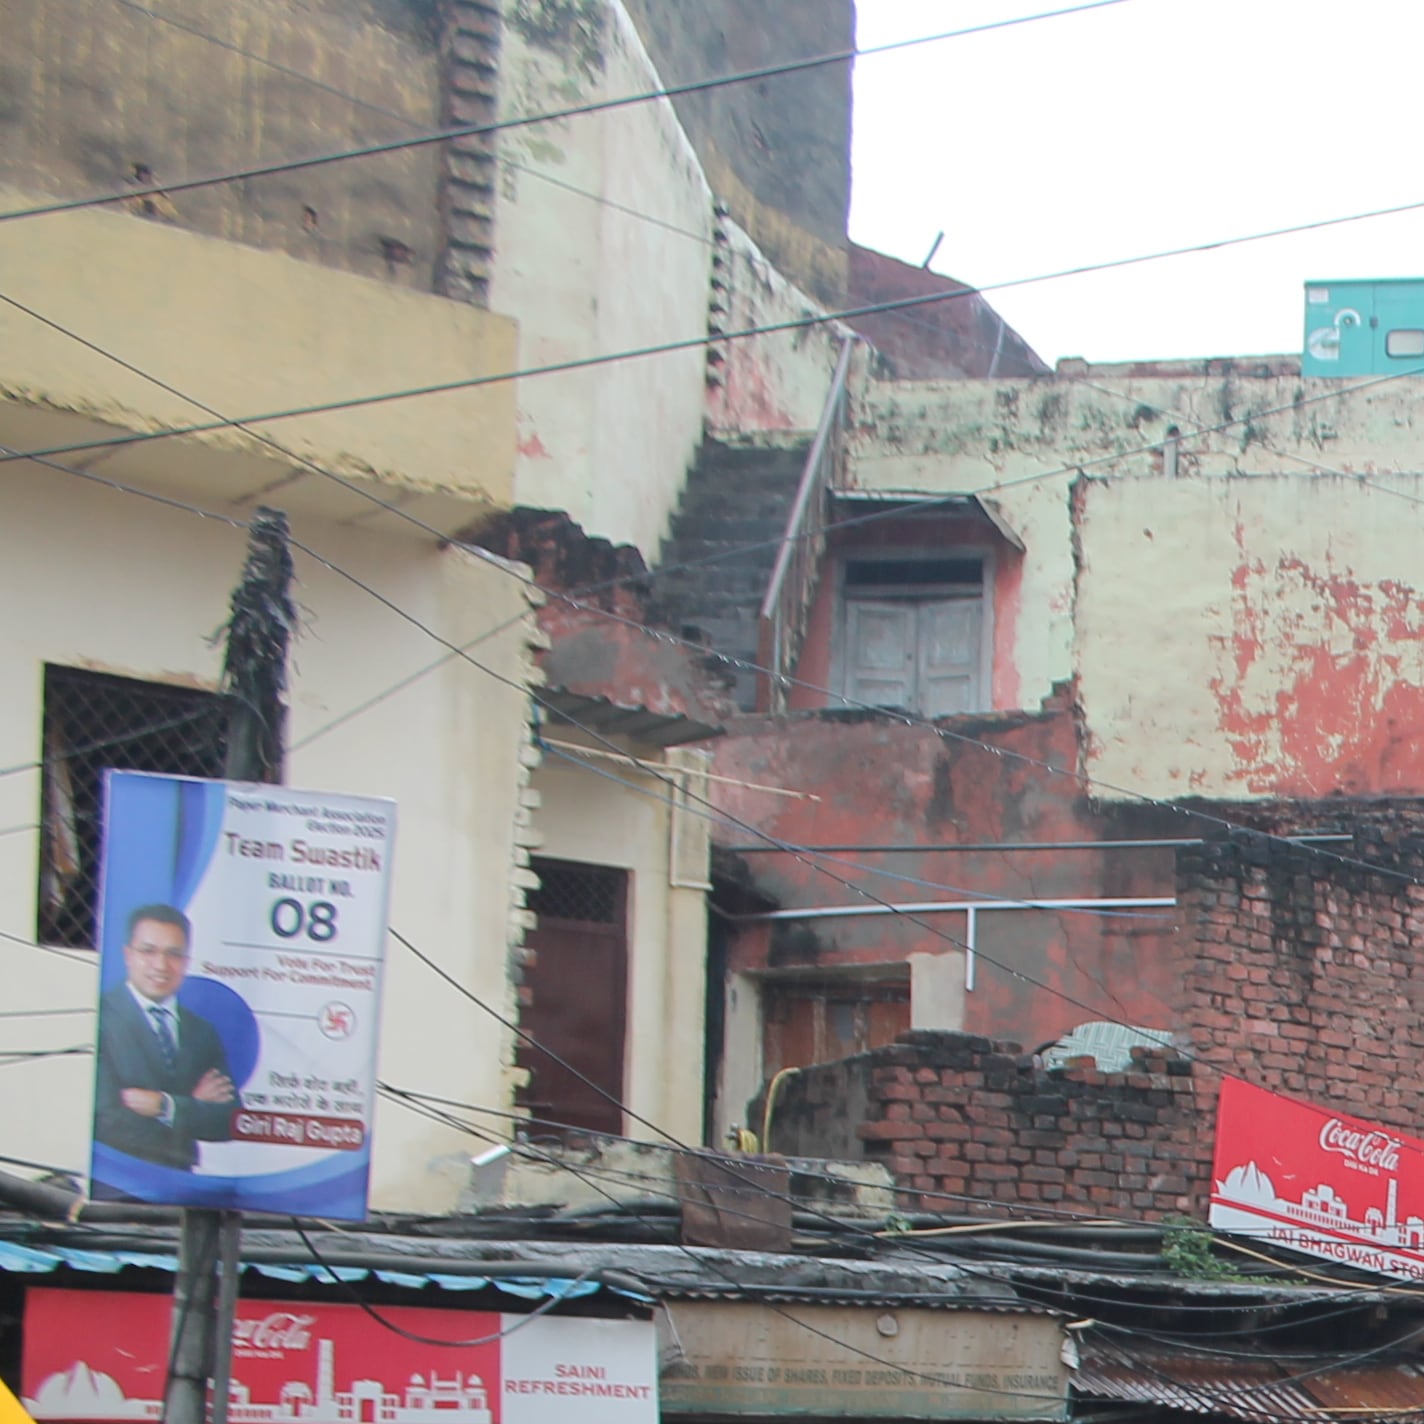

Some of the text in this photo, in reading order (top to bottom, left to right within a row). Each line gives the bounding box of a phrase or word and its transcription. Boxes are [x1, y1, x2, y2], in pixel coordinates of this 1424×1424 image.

[224, 831, 381, 872] Team Swastik
[267, 872, 355, 898] BALLOT NO.
[270, 897, 337, 942] 08
[263, 967, 287, 981] For
[312, 958, 338, 972] For
[236, 1112, 363, 1147] Giri Raj Gupta
[1319, 1119, 1405, 1172] Coca-Cola
[1267, 1225, 1295, 1247] JAI
[1298, 1232, 1385, 1271] BHAGWAN
[554, 1364, 607, 1379] SAINI
[735, 1365, 764, 1382] ISSUE
[767, 1366, 779, 1382] OF
[783, 1367, 827, 1384] SHARES,
[831, 1368, 862, 1385] FIXED
[505, 1379, 652, 1400] REFRESHMENT
